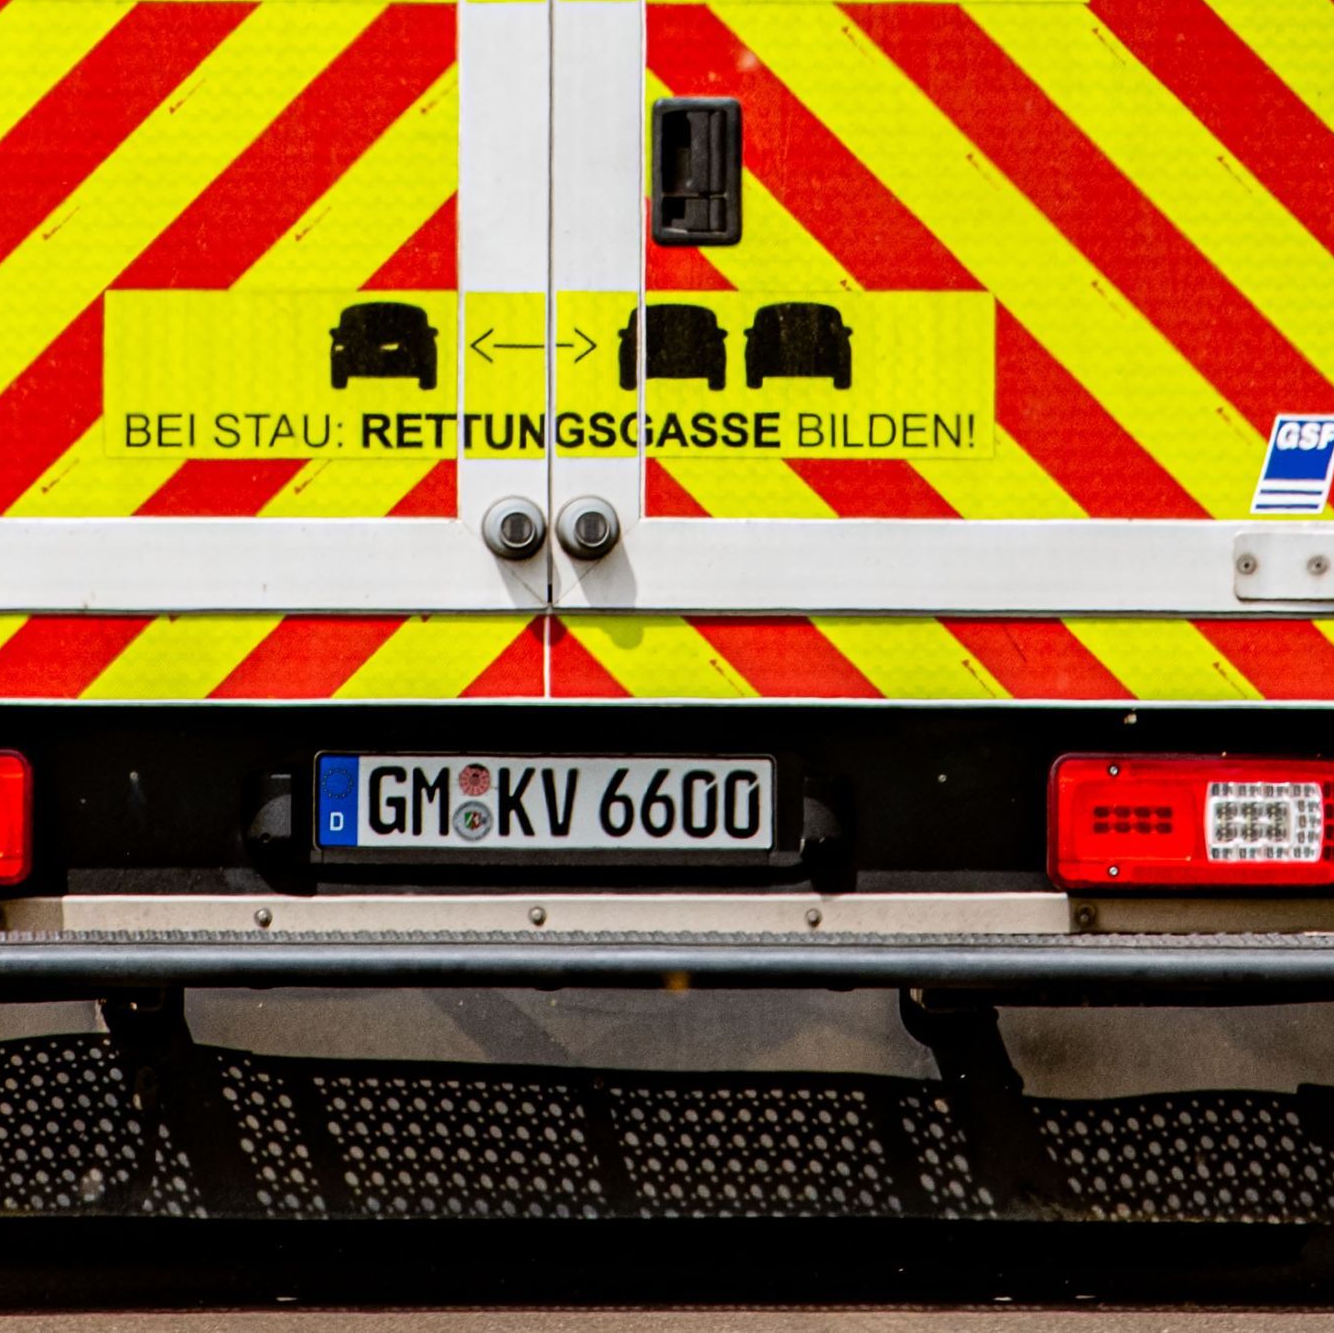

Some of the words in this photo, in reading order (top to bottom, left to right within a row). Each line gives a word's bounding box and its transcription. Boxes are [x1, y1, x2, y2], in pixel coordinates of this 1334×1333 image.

[125, 414, 195, 448] BEI
[214, 414, 343, 448] STAU:
[362, 412, 781, 450] RETTUNGSGASSE
[798, 413, 976, 448] BILDEN!
[329, 812, 344, 831] D
[368, 766, 450, 836] GM
[498, 767, 578, 837] KV
[599, 768, 760, 839] 6600
